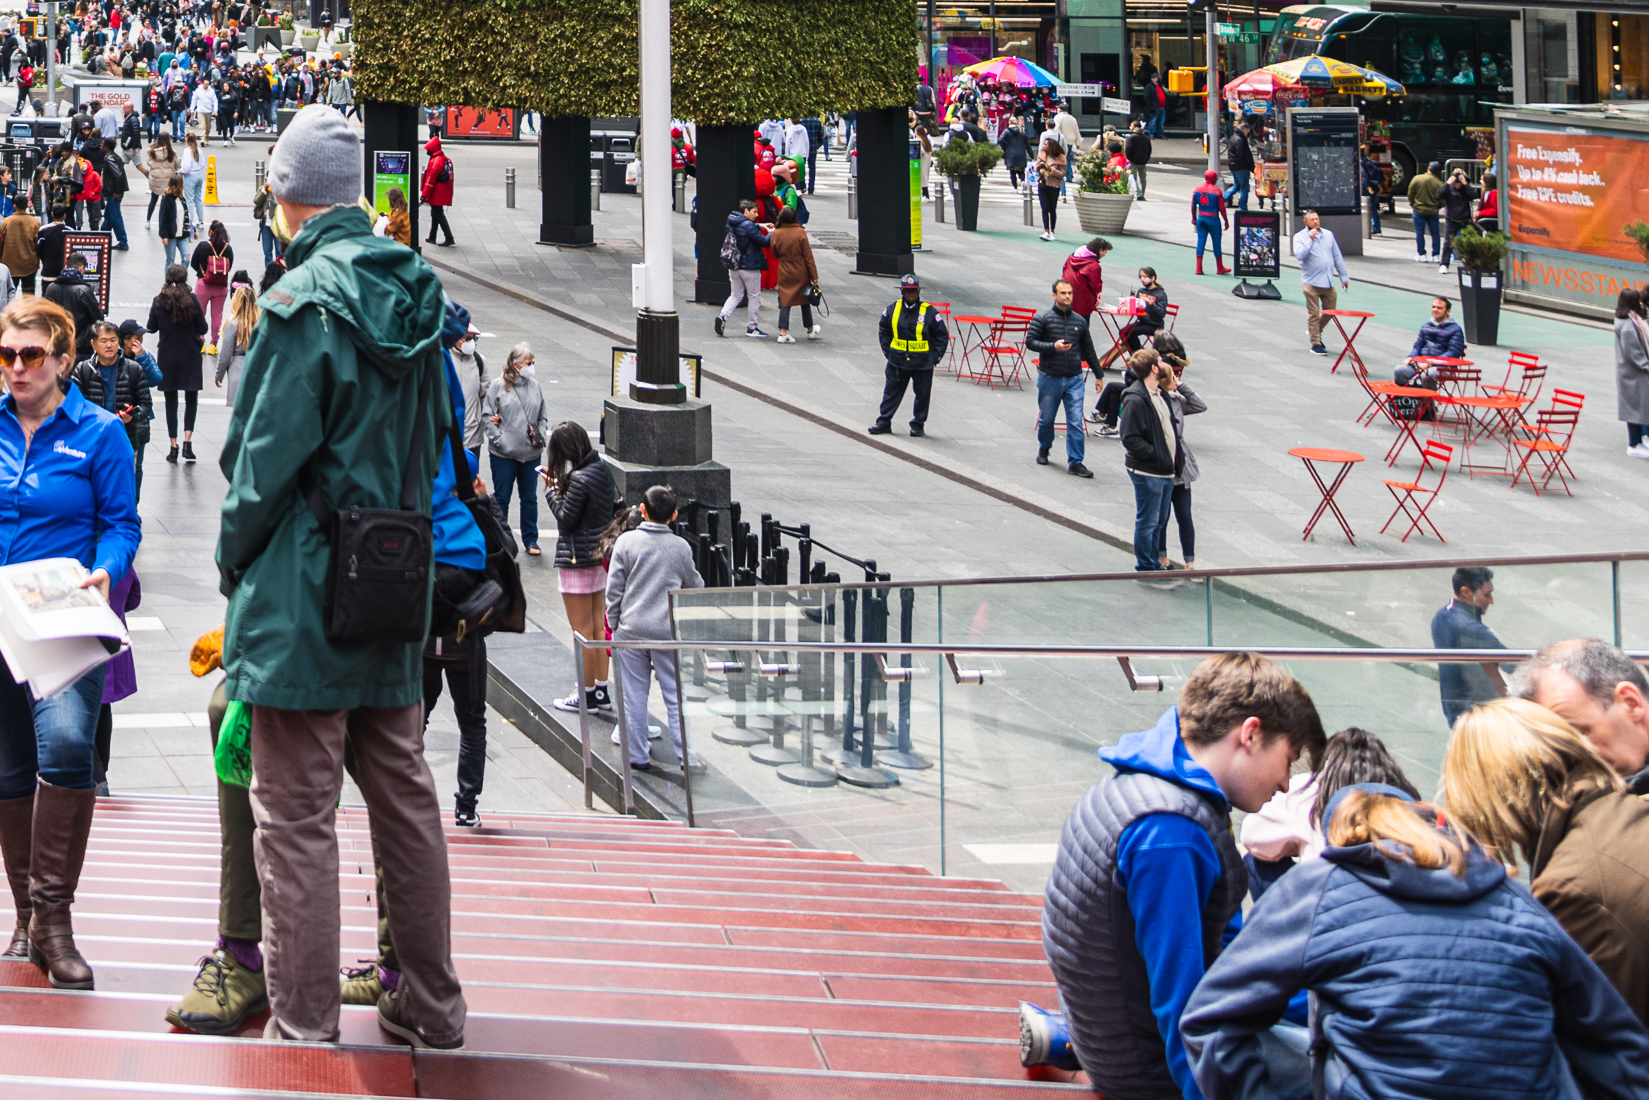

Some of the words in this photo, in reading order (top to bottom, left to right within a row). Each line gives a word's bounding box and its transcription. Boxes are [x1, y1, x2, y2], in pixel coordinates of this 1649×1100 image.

[1228, 35, 1235, 43] W
[1239, 34, 1250, 43] 46
[1276, 88, 1307, 99] Coca-Cola
[1517, 144, 1538, 160] Free
[1538, 146, 1582, 166] Expensify.
[1517, 165, 1530, 182] Up
[1532, 168, 1542, 180] to
[1543, 167, 1556, 182] 4%
[1557, 170, 1578, 185] cash
[1579, 171, 1605, 186] back.
[1517, 185, 1538, 199] Free
[1539, 187, 1557, 202] CPE
[1558, 191, 1594, 206] credits.
[1518, 224, 1550, 238] Expensify
[908, 341, 927, 350] SQUARE
